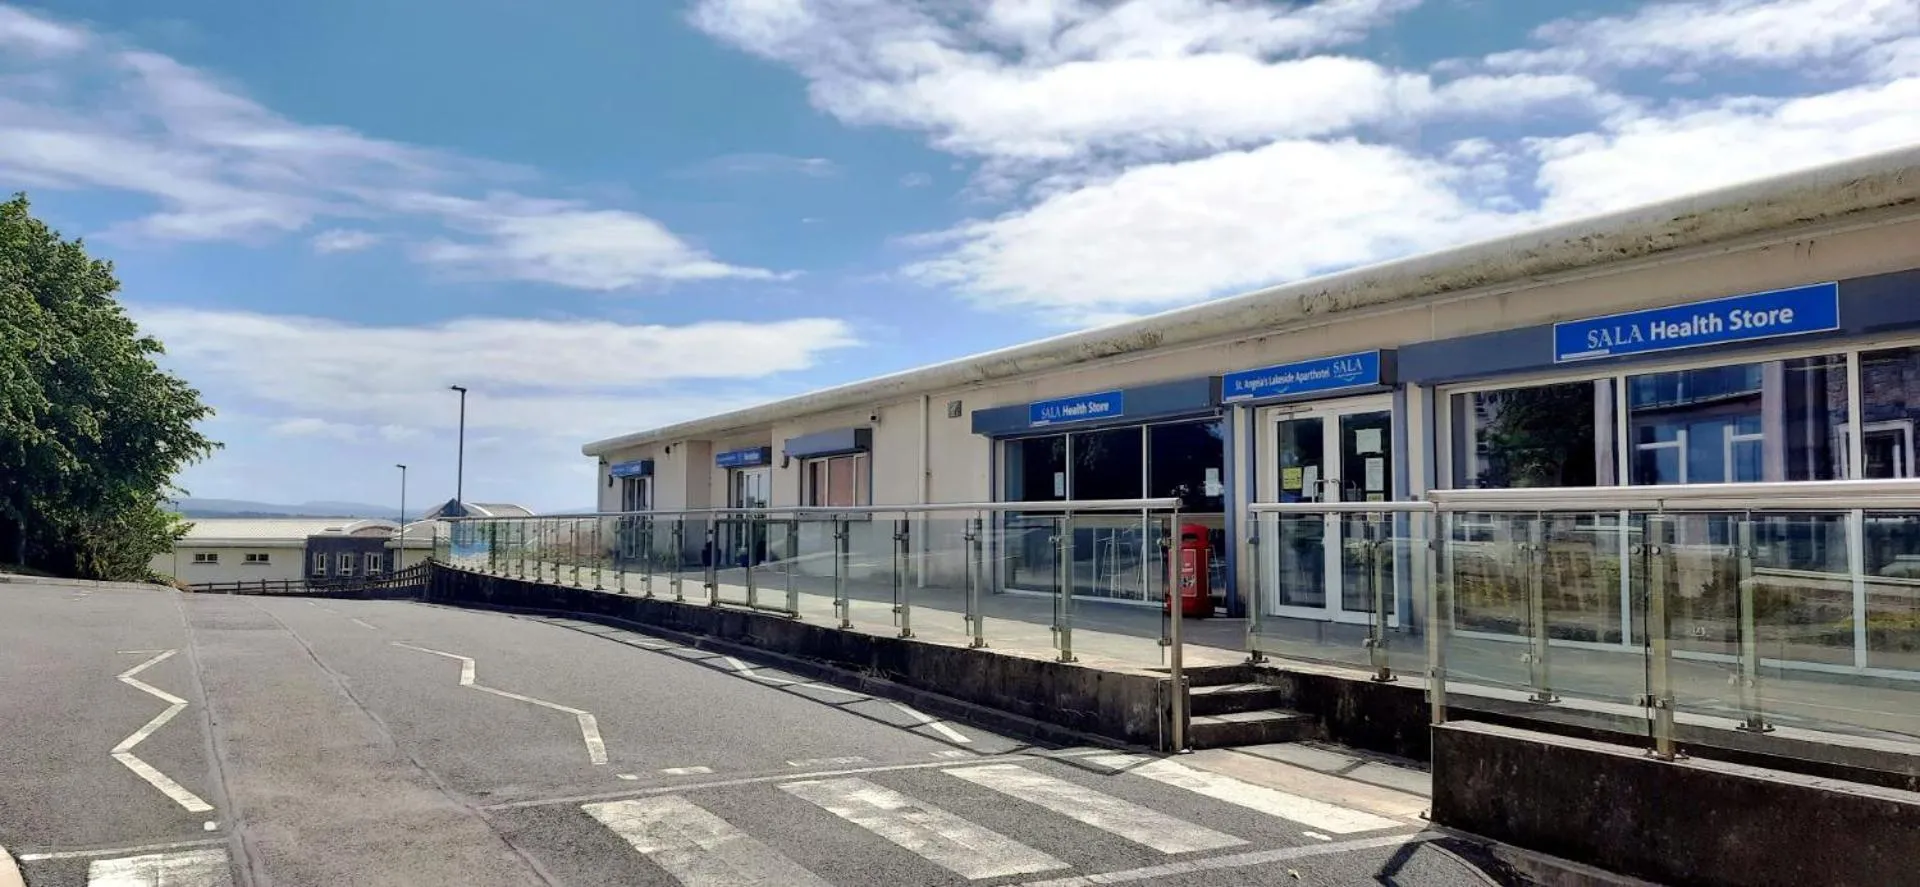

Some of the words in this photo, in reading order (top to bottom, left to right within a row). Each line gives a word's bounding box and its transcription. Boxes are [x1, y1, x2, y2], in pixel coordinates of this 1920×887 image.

[1587, 324, 1643, 350] SALA
[1650, 314, 1723, 341] Health
[1728, 307, 1794, 331] Store
[1333, 358, 1363, 374] SALA
[1244, 375, 1268, 390] Angela's
[1269, 372, 1295, 386] Lakeside
[1296, 367, 1330, 383] Aparthotel
[1041, 406, 1061, 419] SALA
[1062, 402, 1087, 416] Health
[1089, 400, 1110, 413] Store
